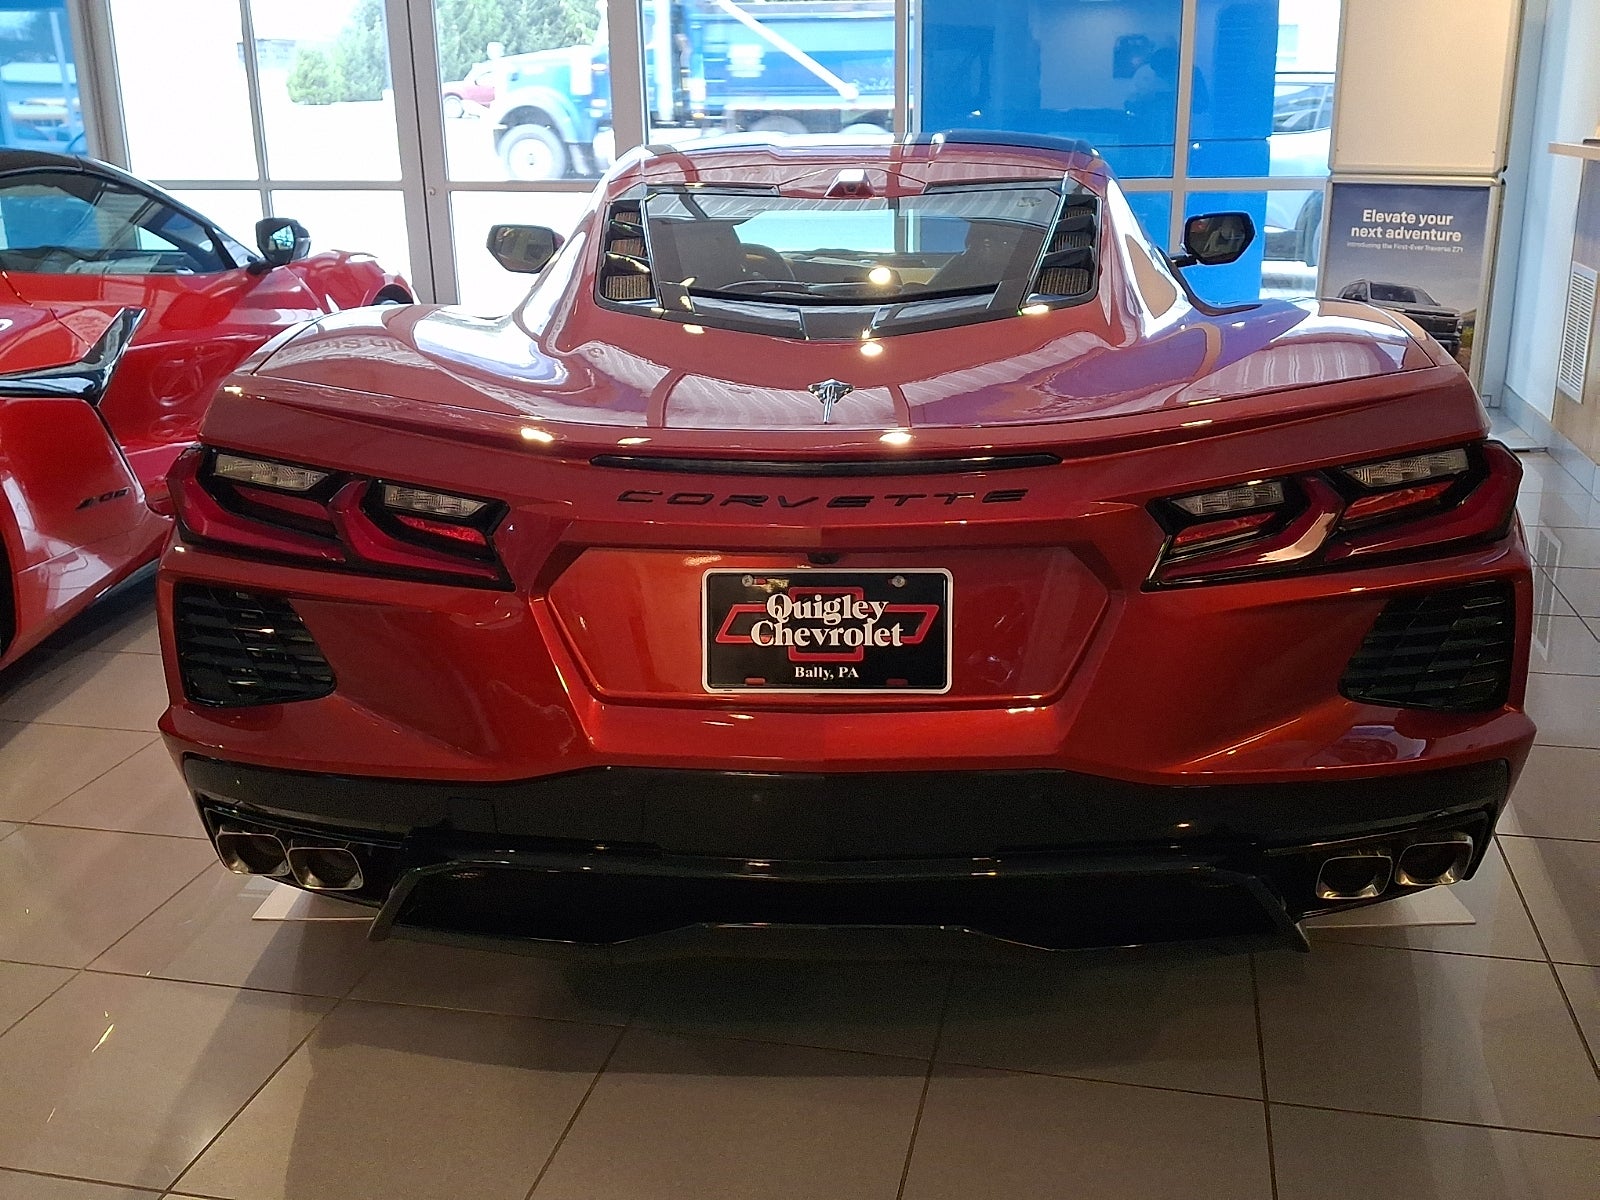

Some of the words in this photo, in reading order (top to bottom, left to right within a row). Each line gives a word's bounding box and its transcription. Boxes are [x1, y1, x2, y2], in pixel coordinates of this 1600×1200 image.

[1363, 209, 1416, 224] Elevate
[1418, 214, 1454, 227] your
[1351, 226, 1383, 238] next
[1386, 226, 1462, 242] adventure
[616, 488, 1030, 508] CORVETTE
[766, 593, 889, 626] Quigley
[750, 619, 904, 647] Chevrolet
[795, 666, 834, 681] Bally,
[839, 666, 859, 678] PA
